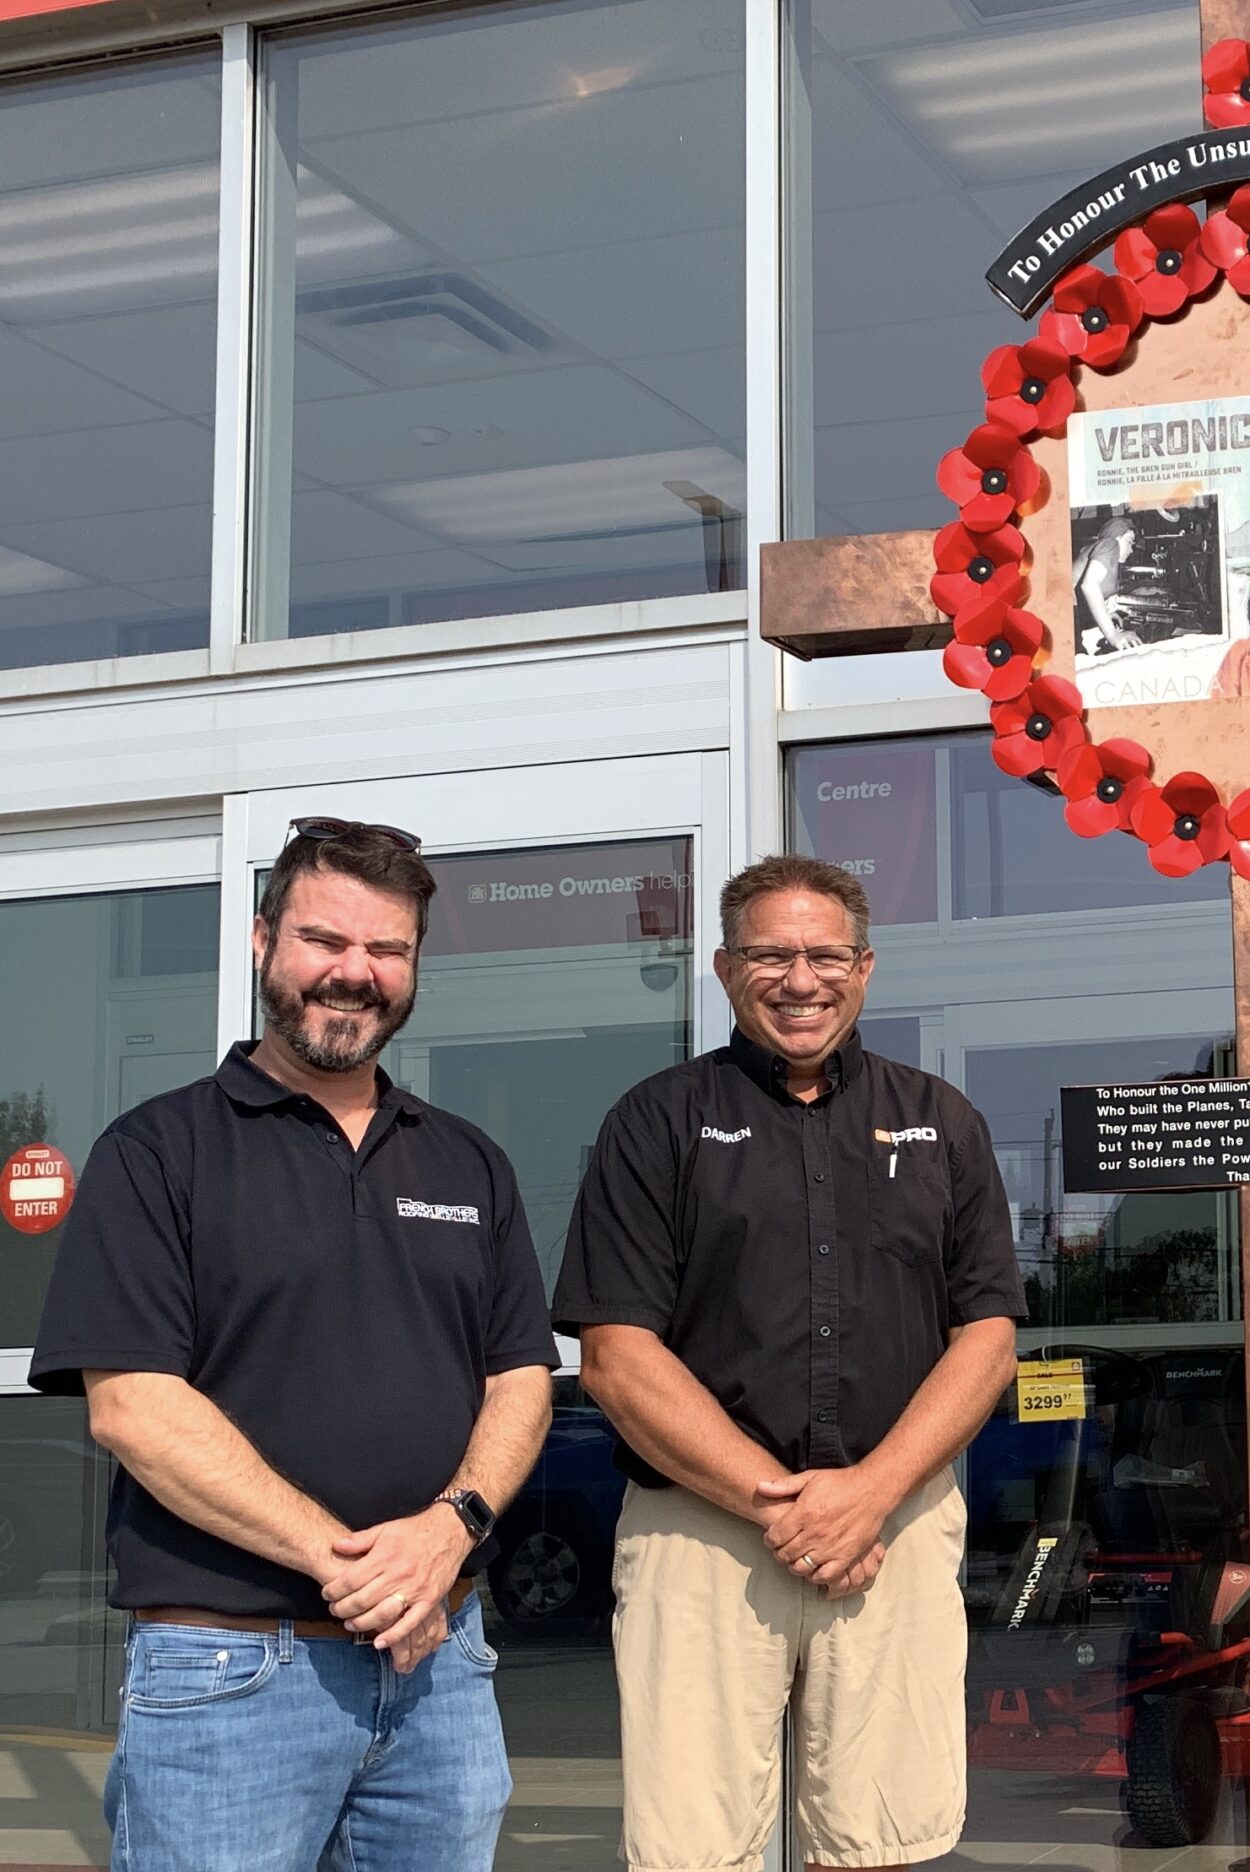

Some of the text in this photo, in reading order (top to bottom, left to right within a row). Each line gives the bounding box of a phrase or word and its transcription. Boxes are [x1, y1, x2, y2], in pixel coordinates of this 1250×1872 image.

[1008, 256, 1041, 284] To
[1036, 183, 1128, 256] Honour
[1129, 157, 1182, 195] The
[1136, 474, 1154, 482] FILLE
[1173, 468, 1221, 480] MITRAILLEUSE
[1095, 674, 1224, 704] CANADA
[817, 782, 891, 801] Centre
[490, 882, 553, 901] Home
[559, 876, 644, 896] Owners
[1096, 1088, 1110, 1099] To
[1114, 1086, 1155, 1098] Honour
[1160, 1086, 1178, 1096] the
[1182, 1084, 1205, 1095] One
[1097, 1106, 1125, 1116] Who
[1130, 1104, 1157, 1115] built
[1163, 1103, 1182, 1113] the
[1188, 1100, 1234, 1112] Planes,
[702, 1126, 751, 1143] DARREN
[890, 1127, 937, 1143] PRO
[1097, 1124, 1127, 1136] They
[1132, 1123, 1157, 1134] may
[1162, 1120, 1191, 1131] have
[1196, 1119, 1230, 1130] never
[1098, 1141, 1122, 1152] but
[1131, 1140, 1163, 1152] they
[1172, 1137, 1211, 1148] made
[1221, 1136, 1243, 1146] the
[12, 1161, 63, 1177] DO NOT
[1099, 1160, 1121, 1170] our
[1129, 1156, 1185, 1169] Soldiers
[1193, 1155, 1214, 1165] the
[15, 1202, 57, 1216] ENTER
[1166, 1368, 1222, 1378] BENCHMARK
[1024, 1395, 1062, 1410] 3299
[1007, 1546, 1052, 1631] BENCHMARK
